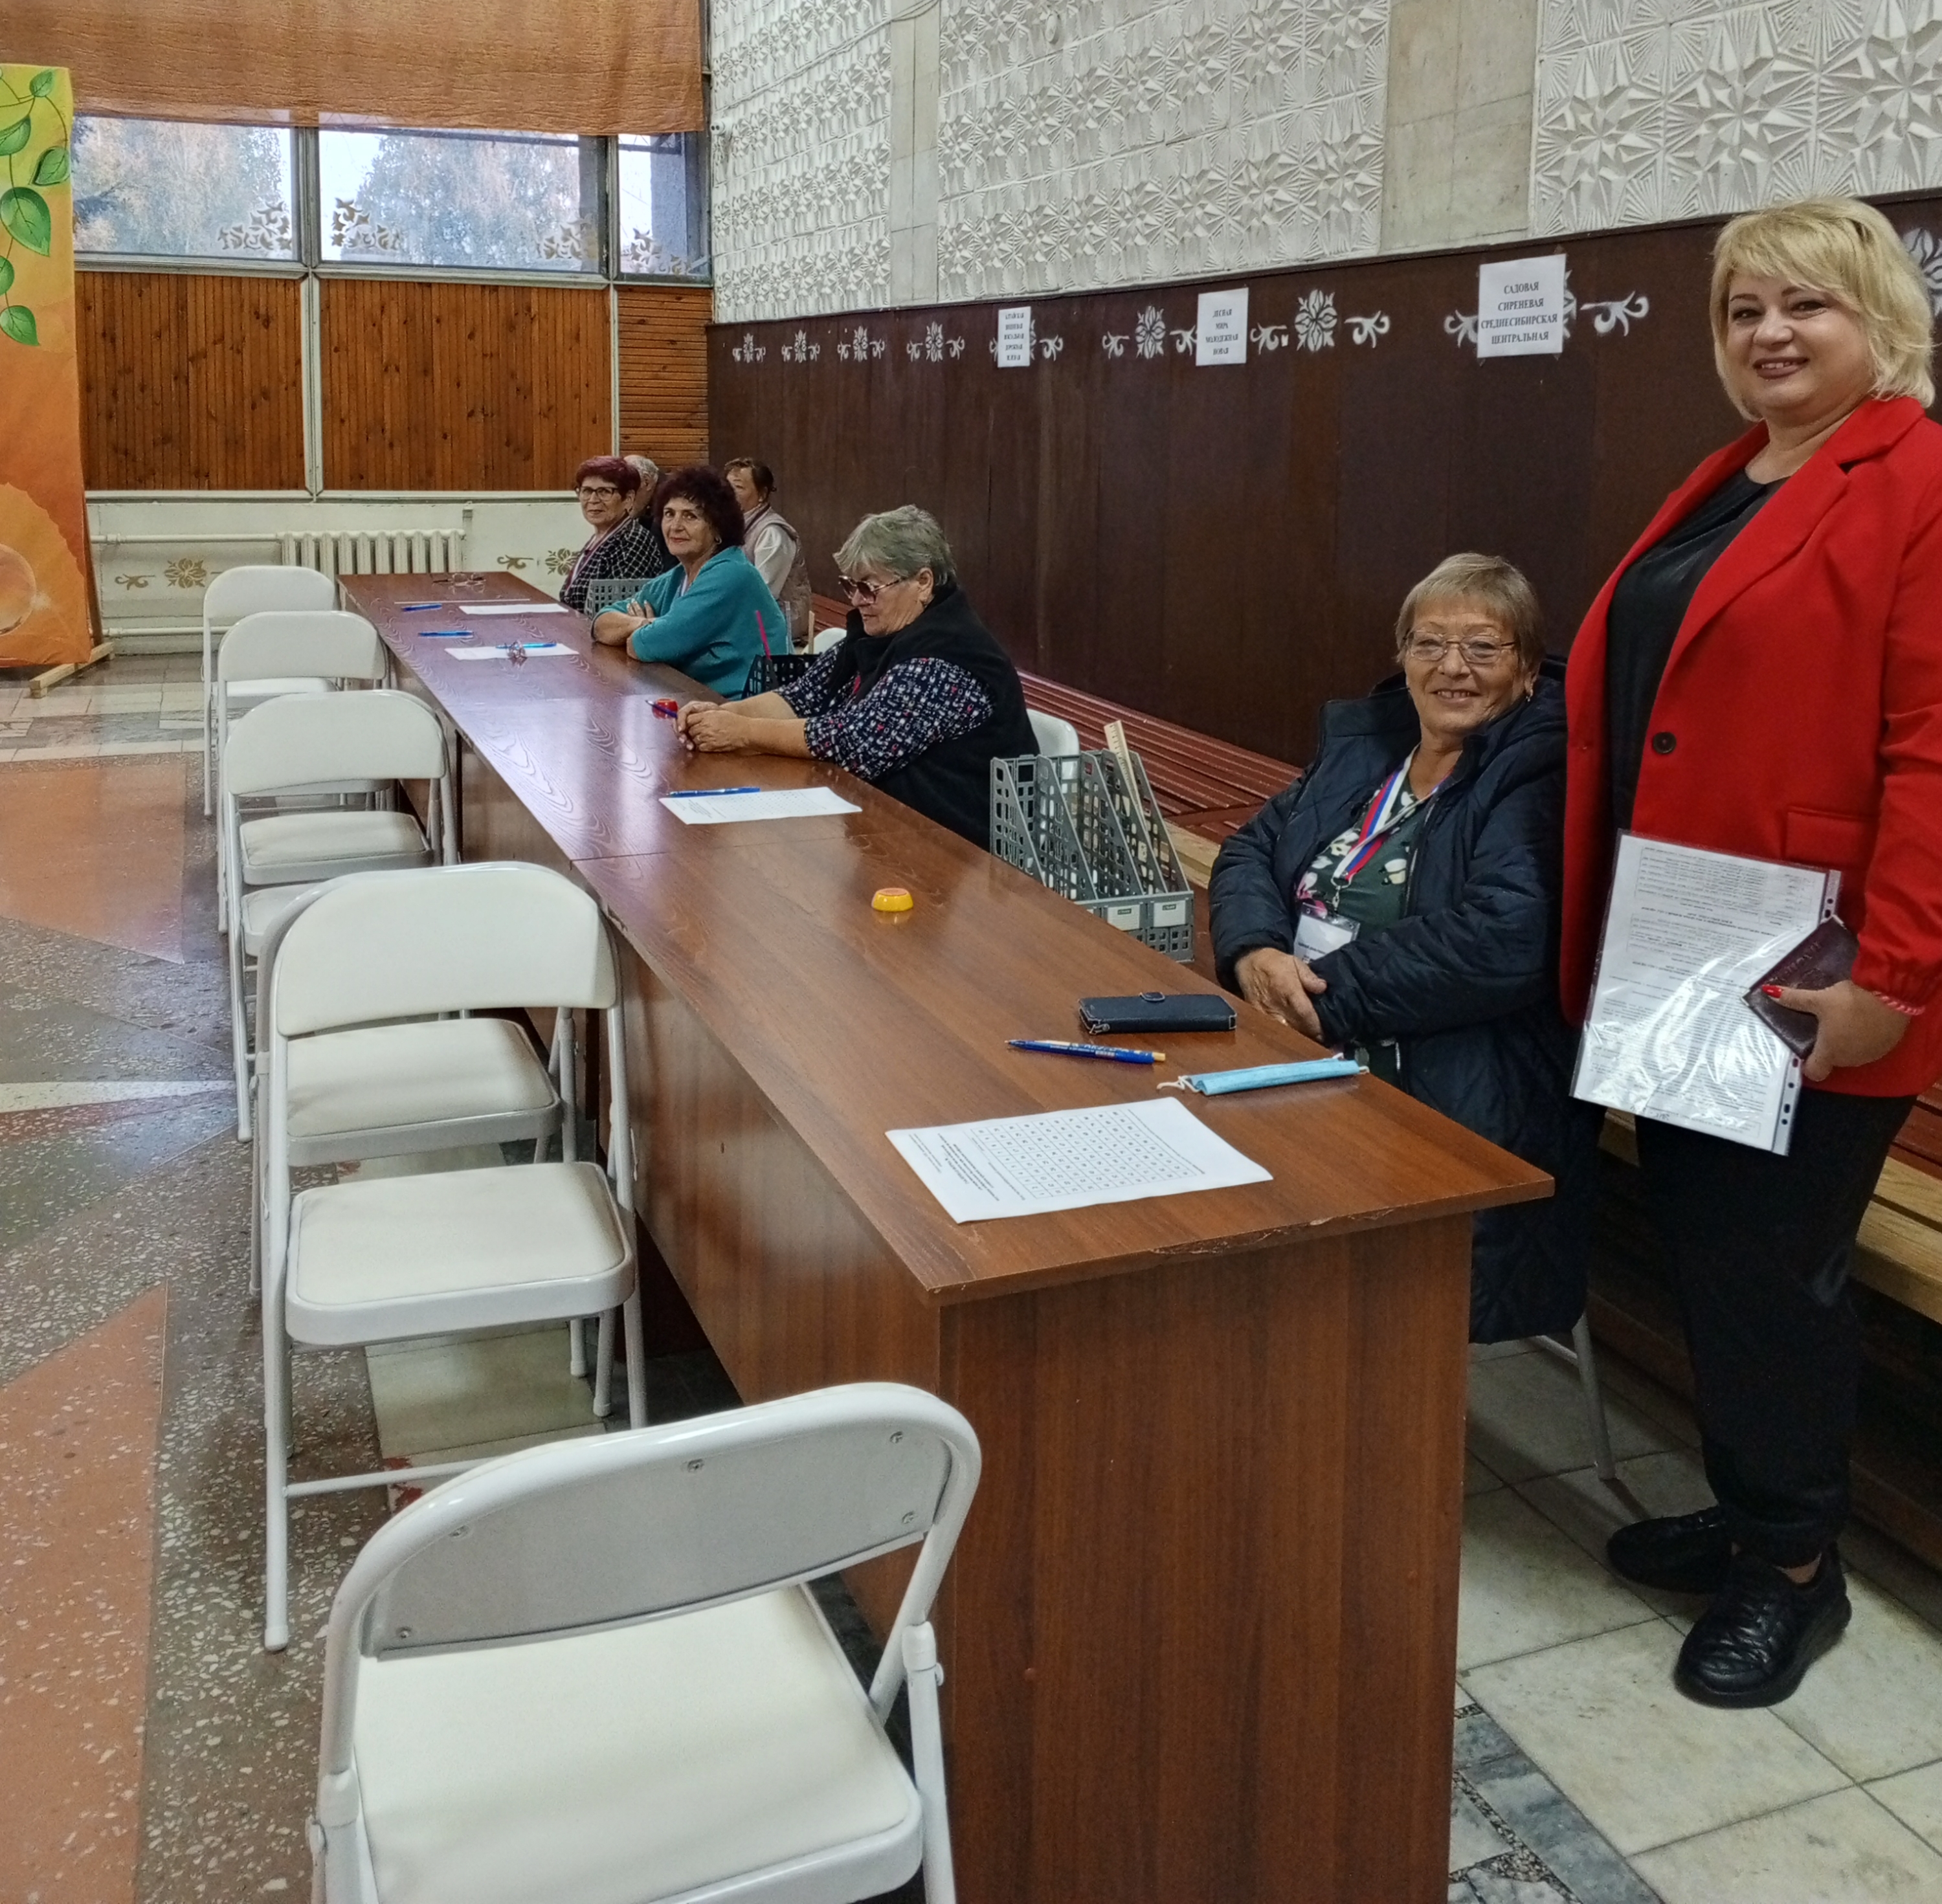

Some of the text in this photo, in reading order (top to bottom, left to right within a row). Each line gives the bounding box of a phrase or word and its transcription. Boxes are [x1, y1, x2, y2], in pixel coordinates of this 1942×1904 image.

[1504, 282, 1539, 294] САДОВАЯ
[1498, 298, 1544, 311] СИРЕНЕВАЯ
[1481, 314, 1557, 329] СРЕДНЕСИБИРСКАЯ
[1491, 331, 1548, 344] ЦЕНТРАЛЬНАЯ
